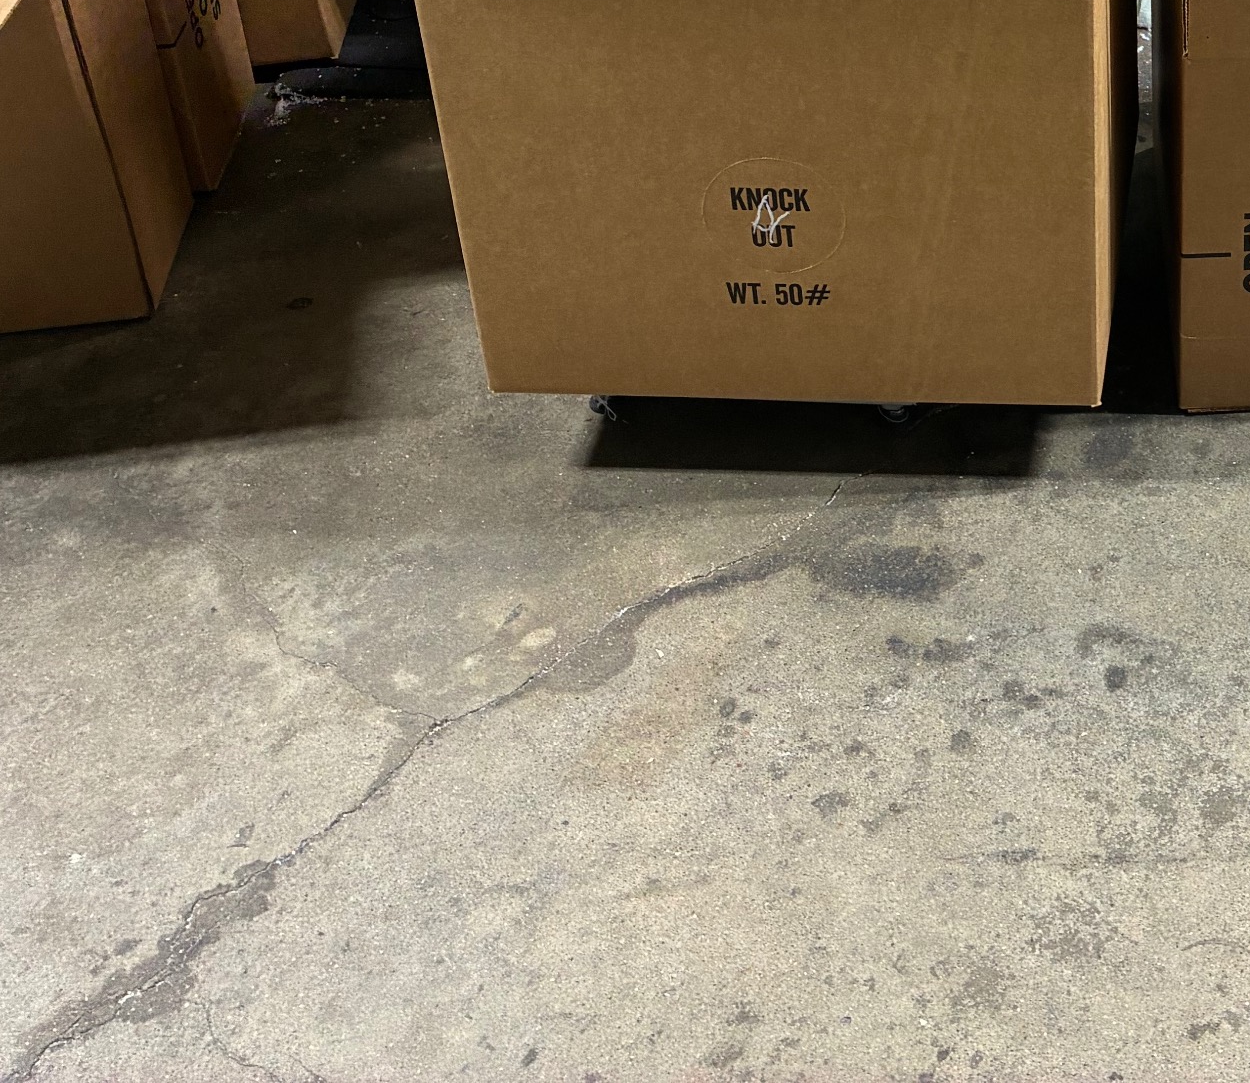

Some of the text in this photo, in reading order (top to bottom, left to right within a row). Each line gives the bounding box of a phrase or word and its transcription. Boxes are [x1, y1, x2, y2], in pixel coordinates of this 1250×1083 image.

[729, 186, 811, 212] KNOCK
[751, 224, 796, 248] OUT
[725, 281, 831, 306] WT. 50#
